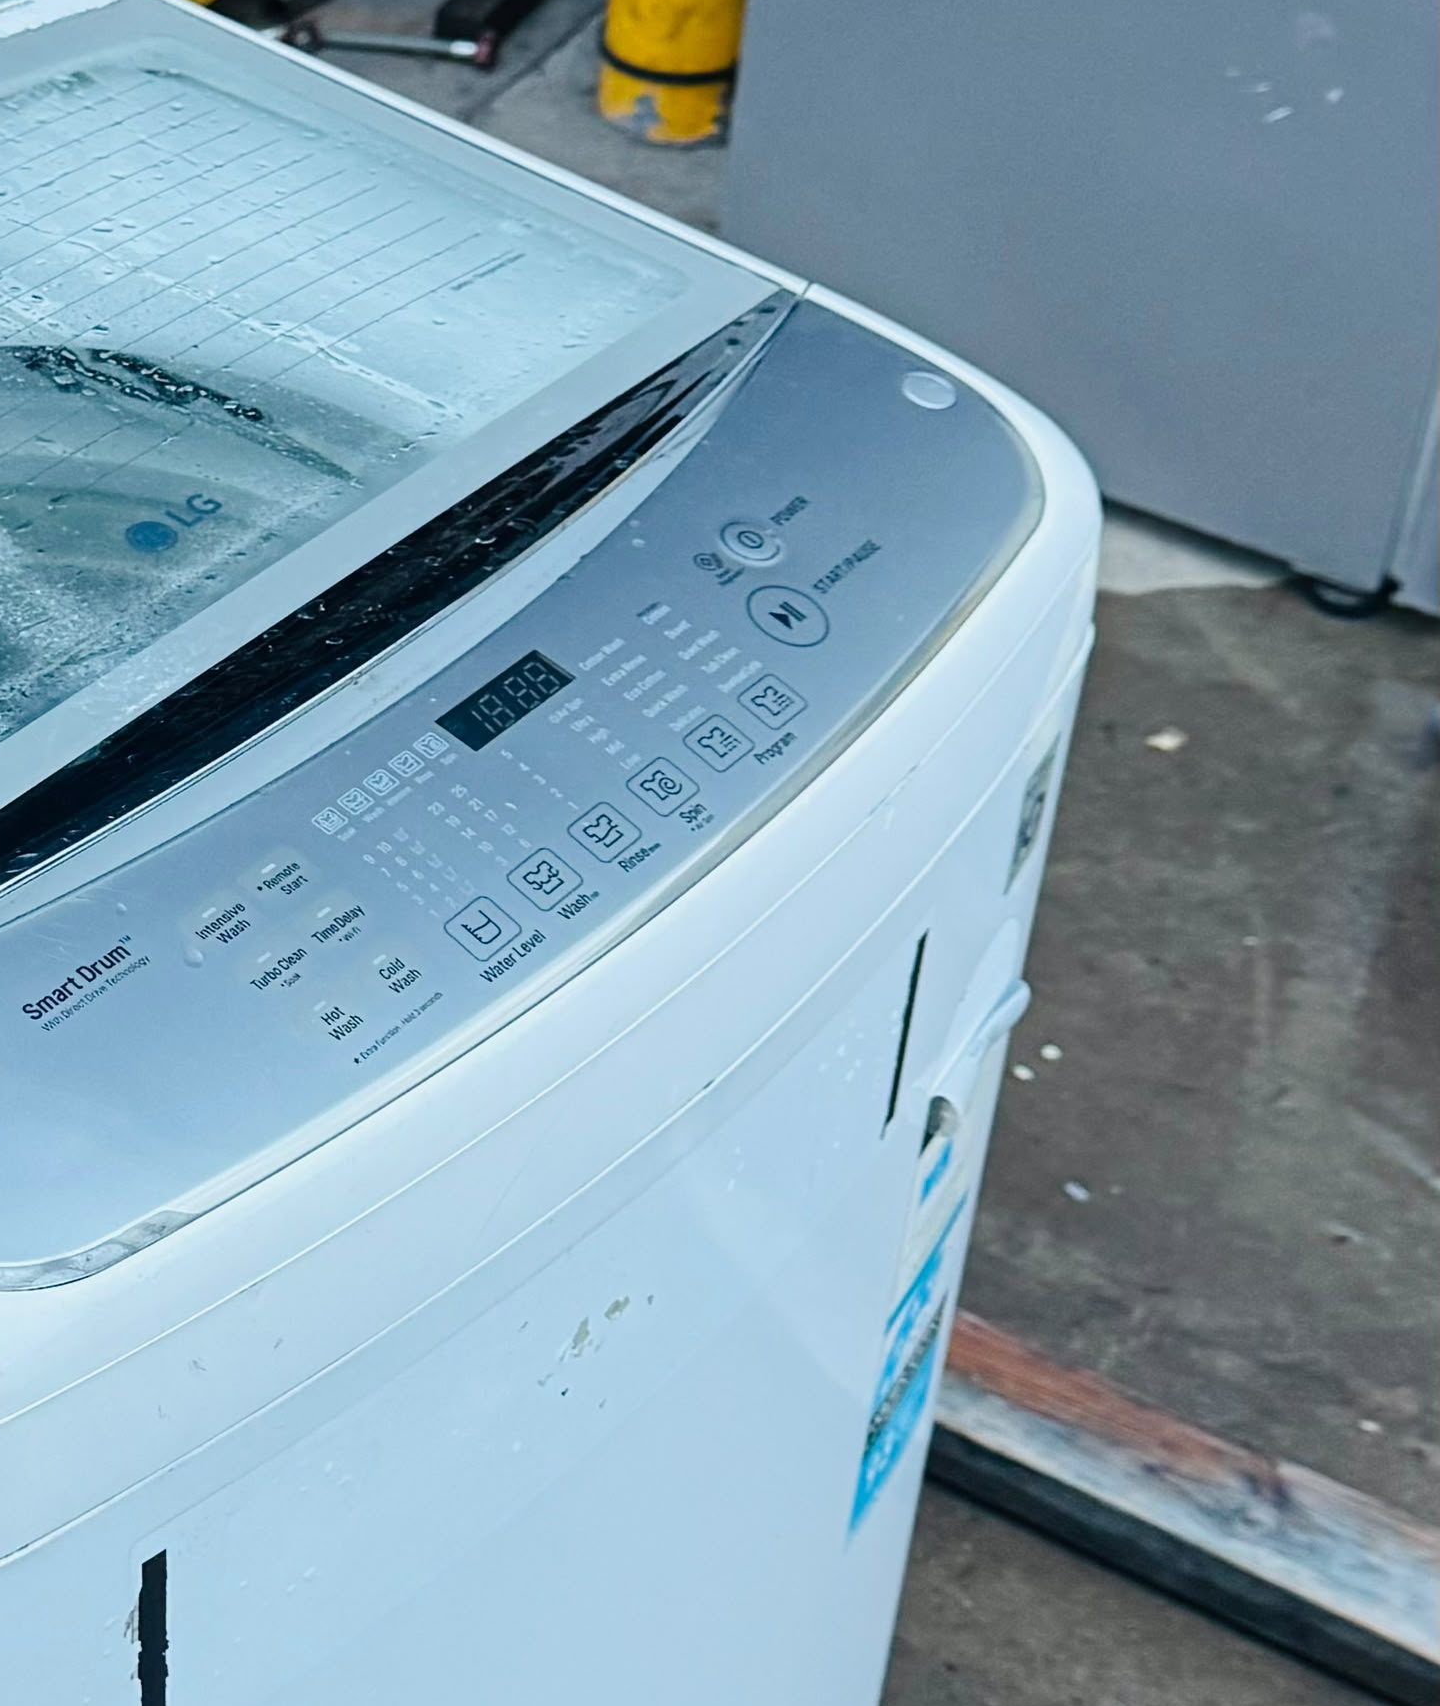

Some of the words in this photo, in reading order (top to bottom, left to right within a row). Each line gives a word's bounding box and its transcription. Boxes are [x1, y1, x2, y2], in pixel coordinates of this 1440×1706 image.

[165, 494, 223, 528] LG
[753, 732, 798, 765] Program
[679, 803, 708, 825] Spin
[618, 847, 651, 873] Rinse
[263, 861, 301, 890] Remote
[280, 874, 309, 896] Start
[558, 891, 591, 921] Wash
[195, 902, 246, 940] Intensive
[216, 918, 251, 944] Wash
[311, 922, 339, 944] Time
[334, 904, 366, 929] Delay
[250, 966, 282, 991] Turbo
[278, 947, 308, 972] Clean
[379, 957, 406, 981] Cold
[480, 953, 517, 983] Water
[512, 929, 547, 958] Level
[388, 968, 423, 994] Wash
[22, 977, 84, 1020] Smart
[320, 1005, 346, 1027] Hot
[328, 1013, 364, 1041] Wash
